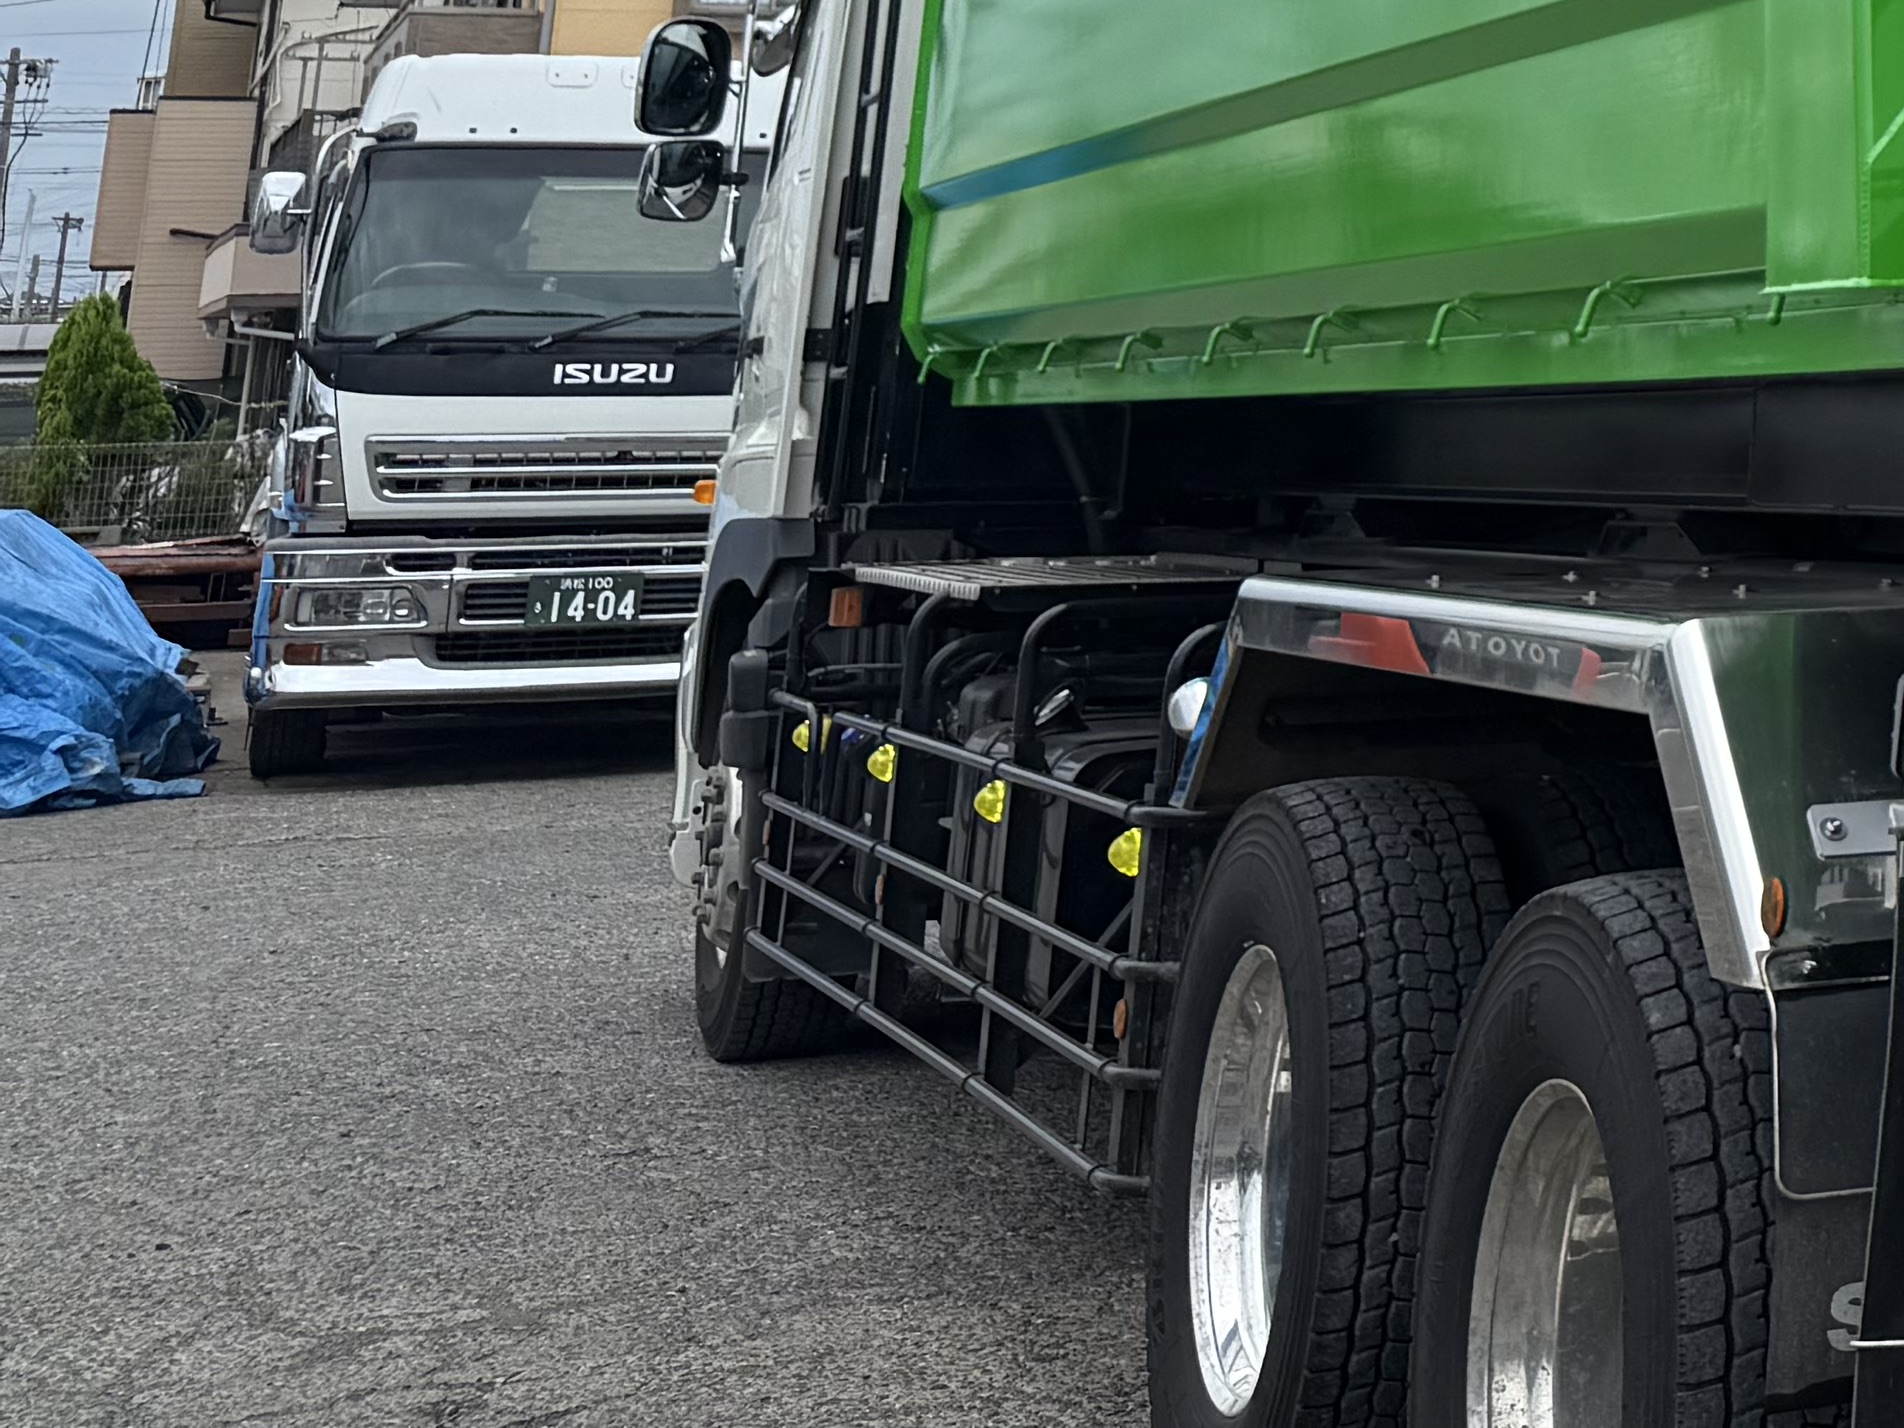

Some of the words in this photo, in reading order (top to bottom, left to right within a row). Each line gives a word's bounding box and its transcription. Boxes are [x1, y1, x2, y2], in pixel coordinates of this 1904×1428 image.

[554, 362, 674, 385] ISUZU
[588, 576, 614, 590] 100
[550, 590, 636, 623] 14-04
